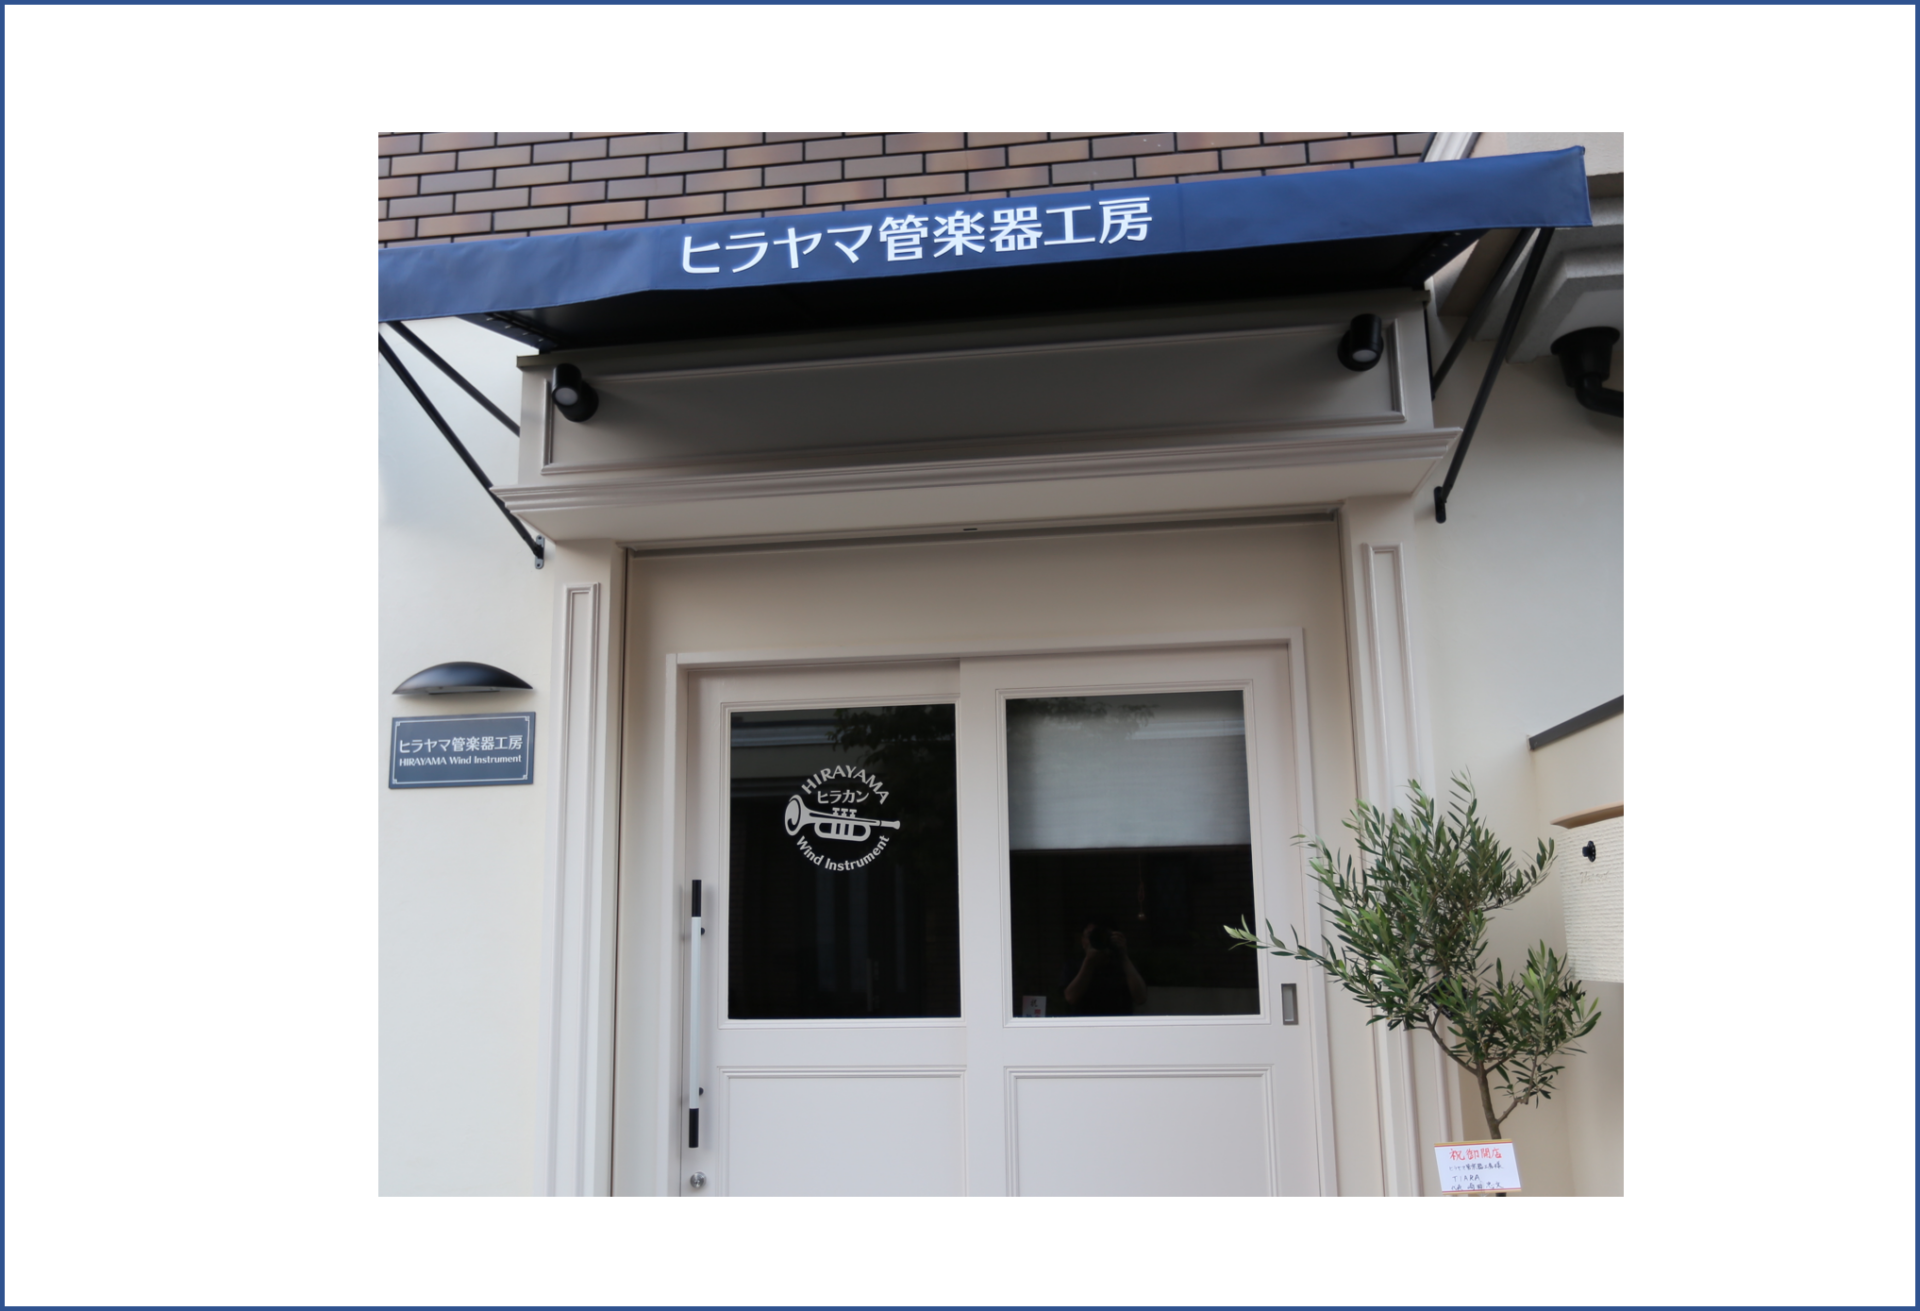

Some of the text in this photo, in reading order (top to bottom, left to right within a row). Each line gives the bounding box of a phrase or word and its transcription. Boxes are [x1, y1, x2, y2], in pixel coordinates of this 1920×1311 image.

[682, 196, 1152, 275] ヒラヤマ管楽器工房
[400, 735, 523, 753] ヒラヤマ管楽器工房
[399, 754, 522, 767] HIRAYAMA Wind Instrument
[801, 765, 889, 805] HIRAYAMA
[817, 790, 869, 804] ヒラカン
[797, 835, 890, 871] Wind Instrument
